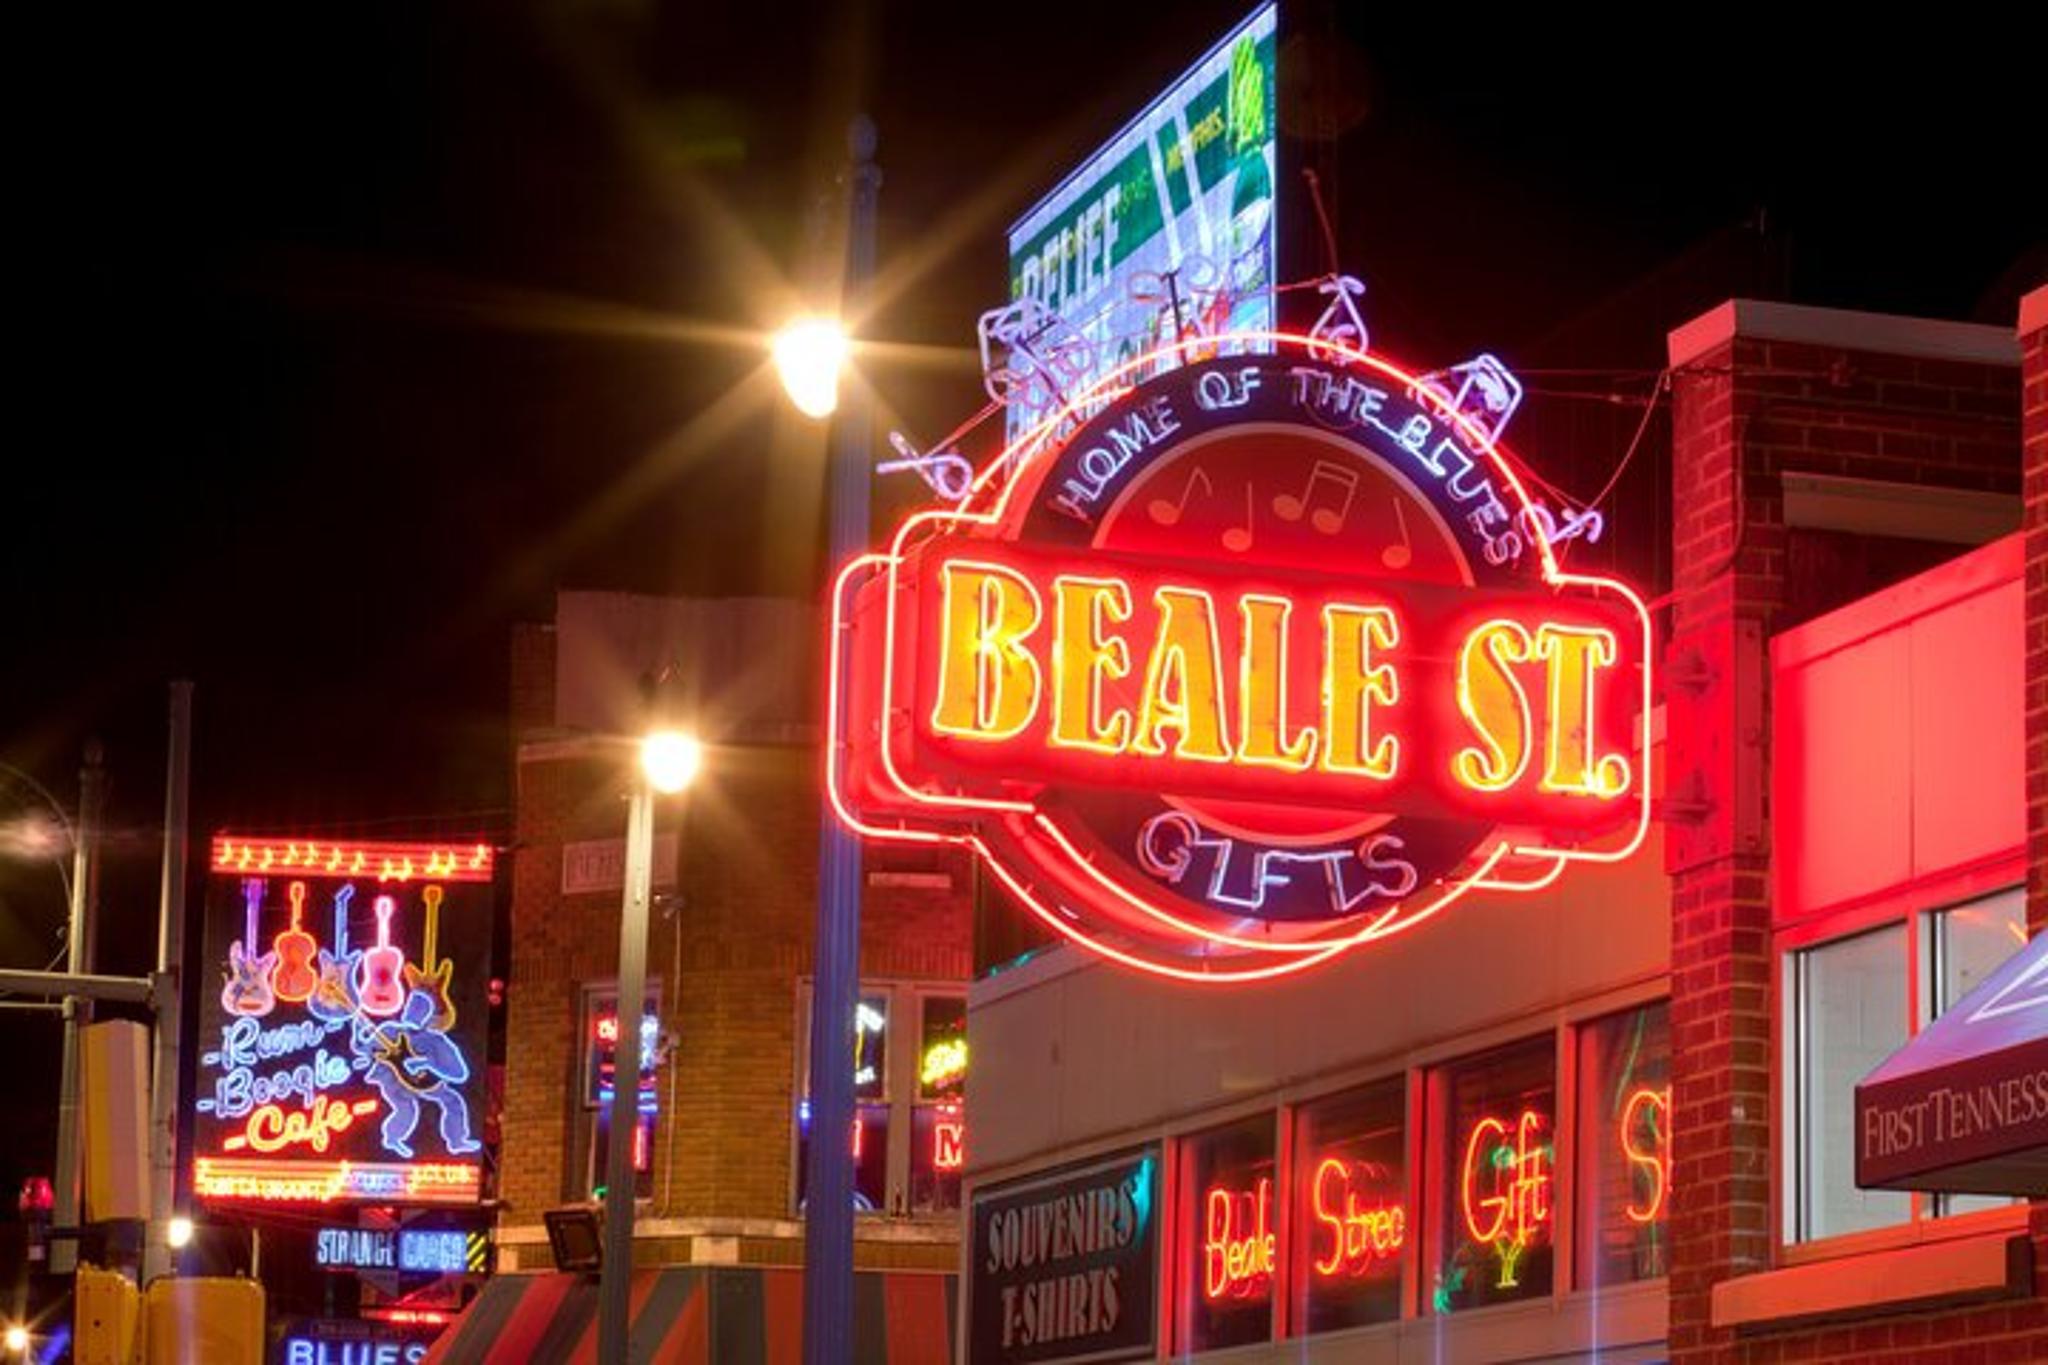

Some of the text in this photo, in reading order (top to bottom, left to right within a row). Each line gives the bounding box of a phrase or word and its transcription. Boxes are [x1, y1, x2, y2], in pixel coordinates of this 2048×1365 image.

[1056, 366, 1523, 566] HOME OF THE BLUES
[932, 559, 1632, 798] BEALE ST.
[1137, 810, 1419, 912] GIFTS
[246, 1094, 352, 1152] Cafe
[1622, 1085, 1673, 1222] S
[1865, 1102, 1929, 1160] FIRST
[986, 1178, 1134, 1275] SOUVENIRS
[1001, 1264, 1119, 1347] T-SHIRTS
